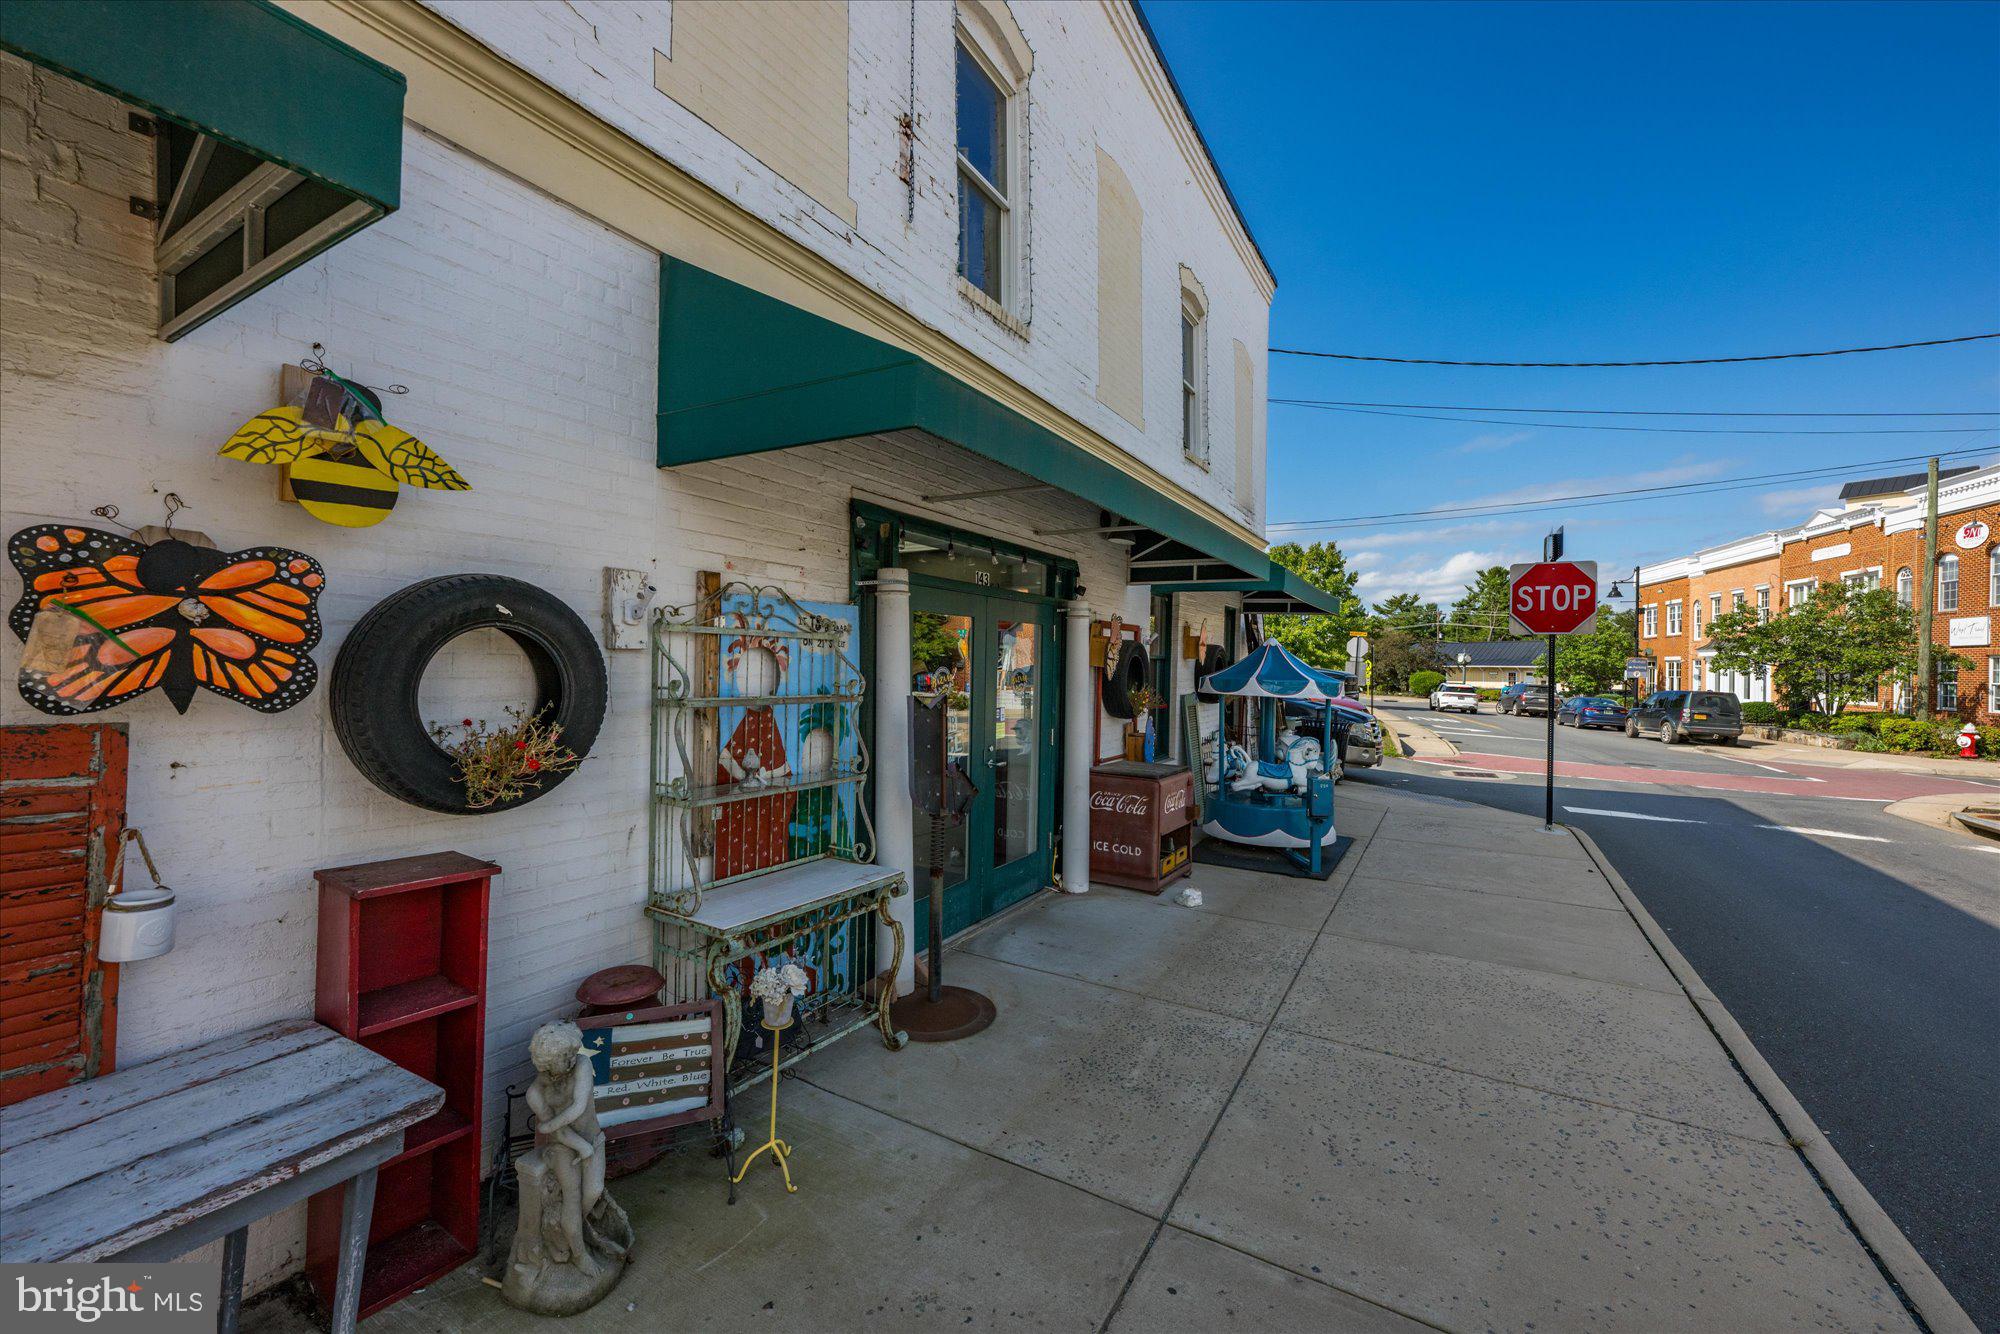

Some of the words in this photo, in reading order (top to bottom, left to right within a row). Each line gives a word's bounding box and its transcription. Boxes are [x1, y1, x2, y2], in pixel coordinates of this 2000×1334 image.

[976, 571, 990, 586] 143
[1516, 584, 1591, 612] STOP
[1093, 840, 1109, 852] ICE
[1112, 843, 1142, 856] COLD
[611, 1056, 654, 1067] Forever
[662, 1052, 675, 1061] Be
[683, 1047, 708, 1057] True
[682, 1072, 707, 1082] Blue
